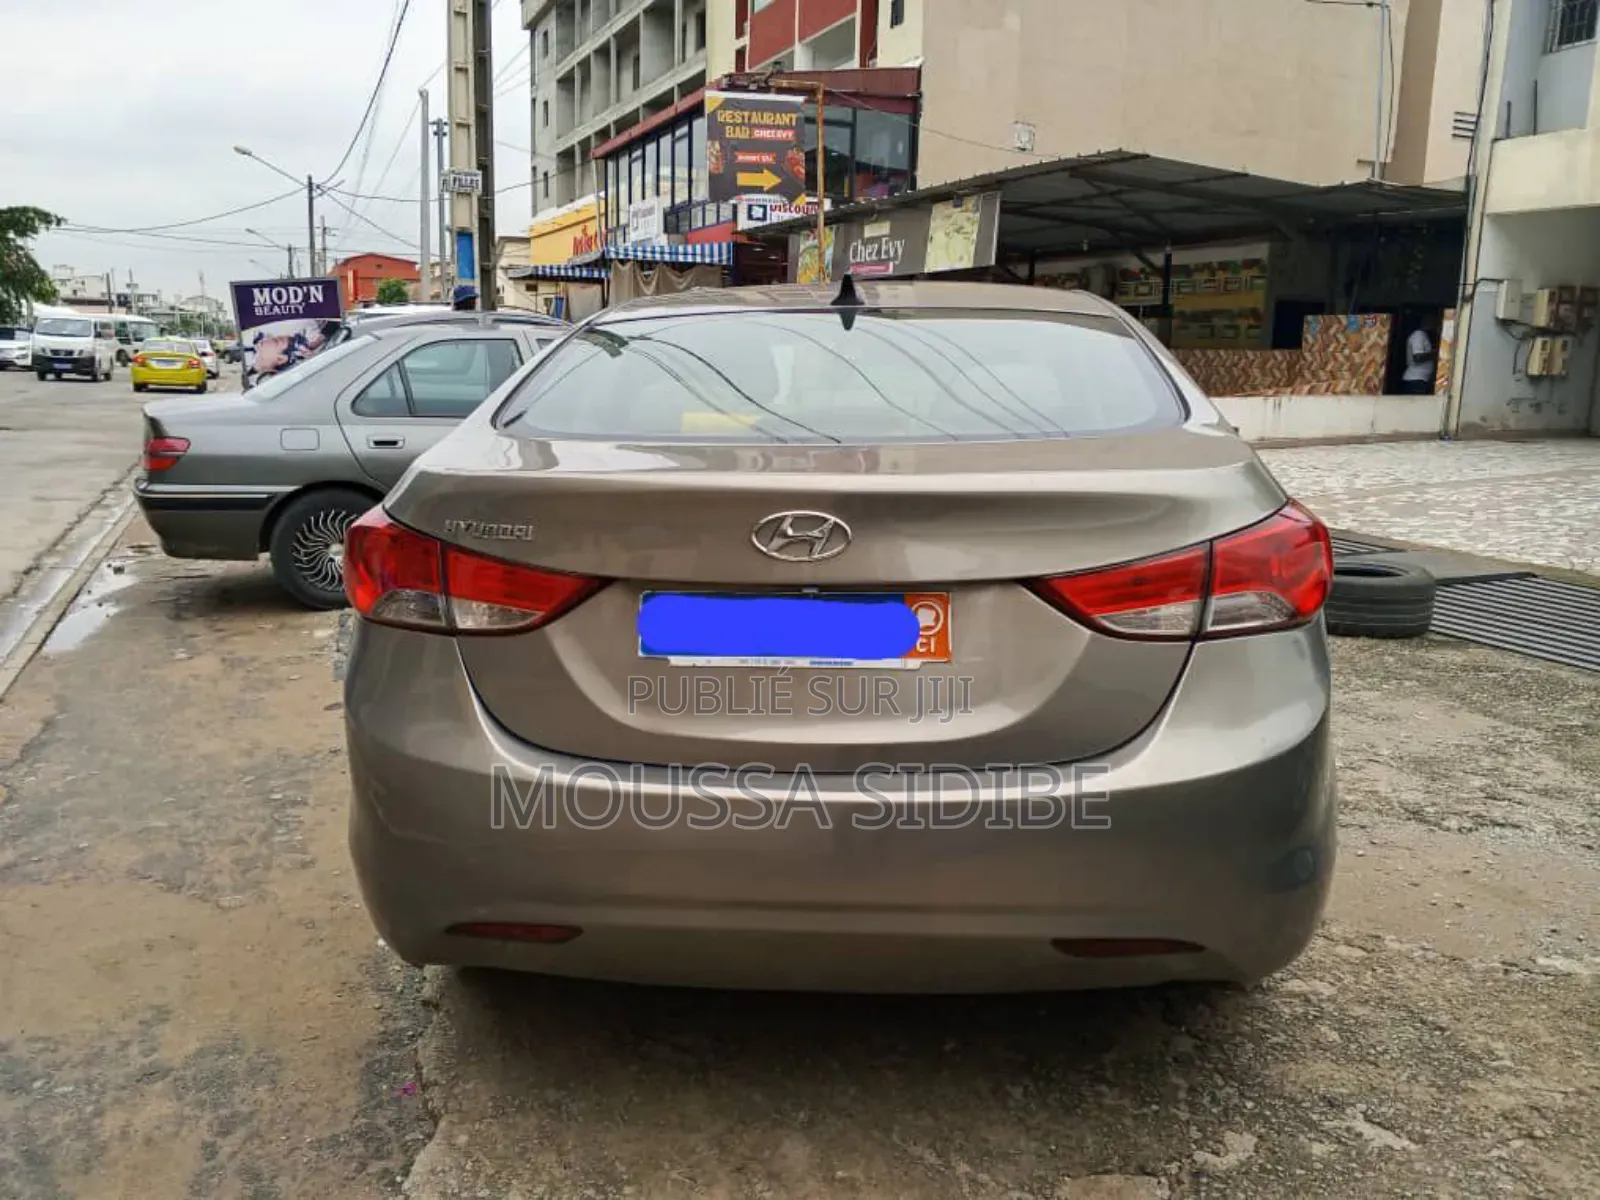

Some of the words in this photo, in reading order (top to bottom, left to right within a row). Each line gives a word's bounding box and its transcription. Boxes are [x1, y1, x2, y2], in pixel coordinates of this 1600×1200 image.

[717, 110, 798, 126] RESTAURANT
[850, 240, 878, 263] Chez
[880, 237, 905, 264] Evy
[252, 284, 324, 306] MOD'N
[254, 303, 306, 316] BEAUTY
